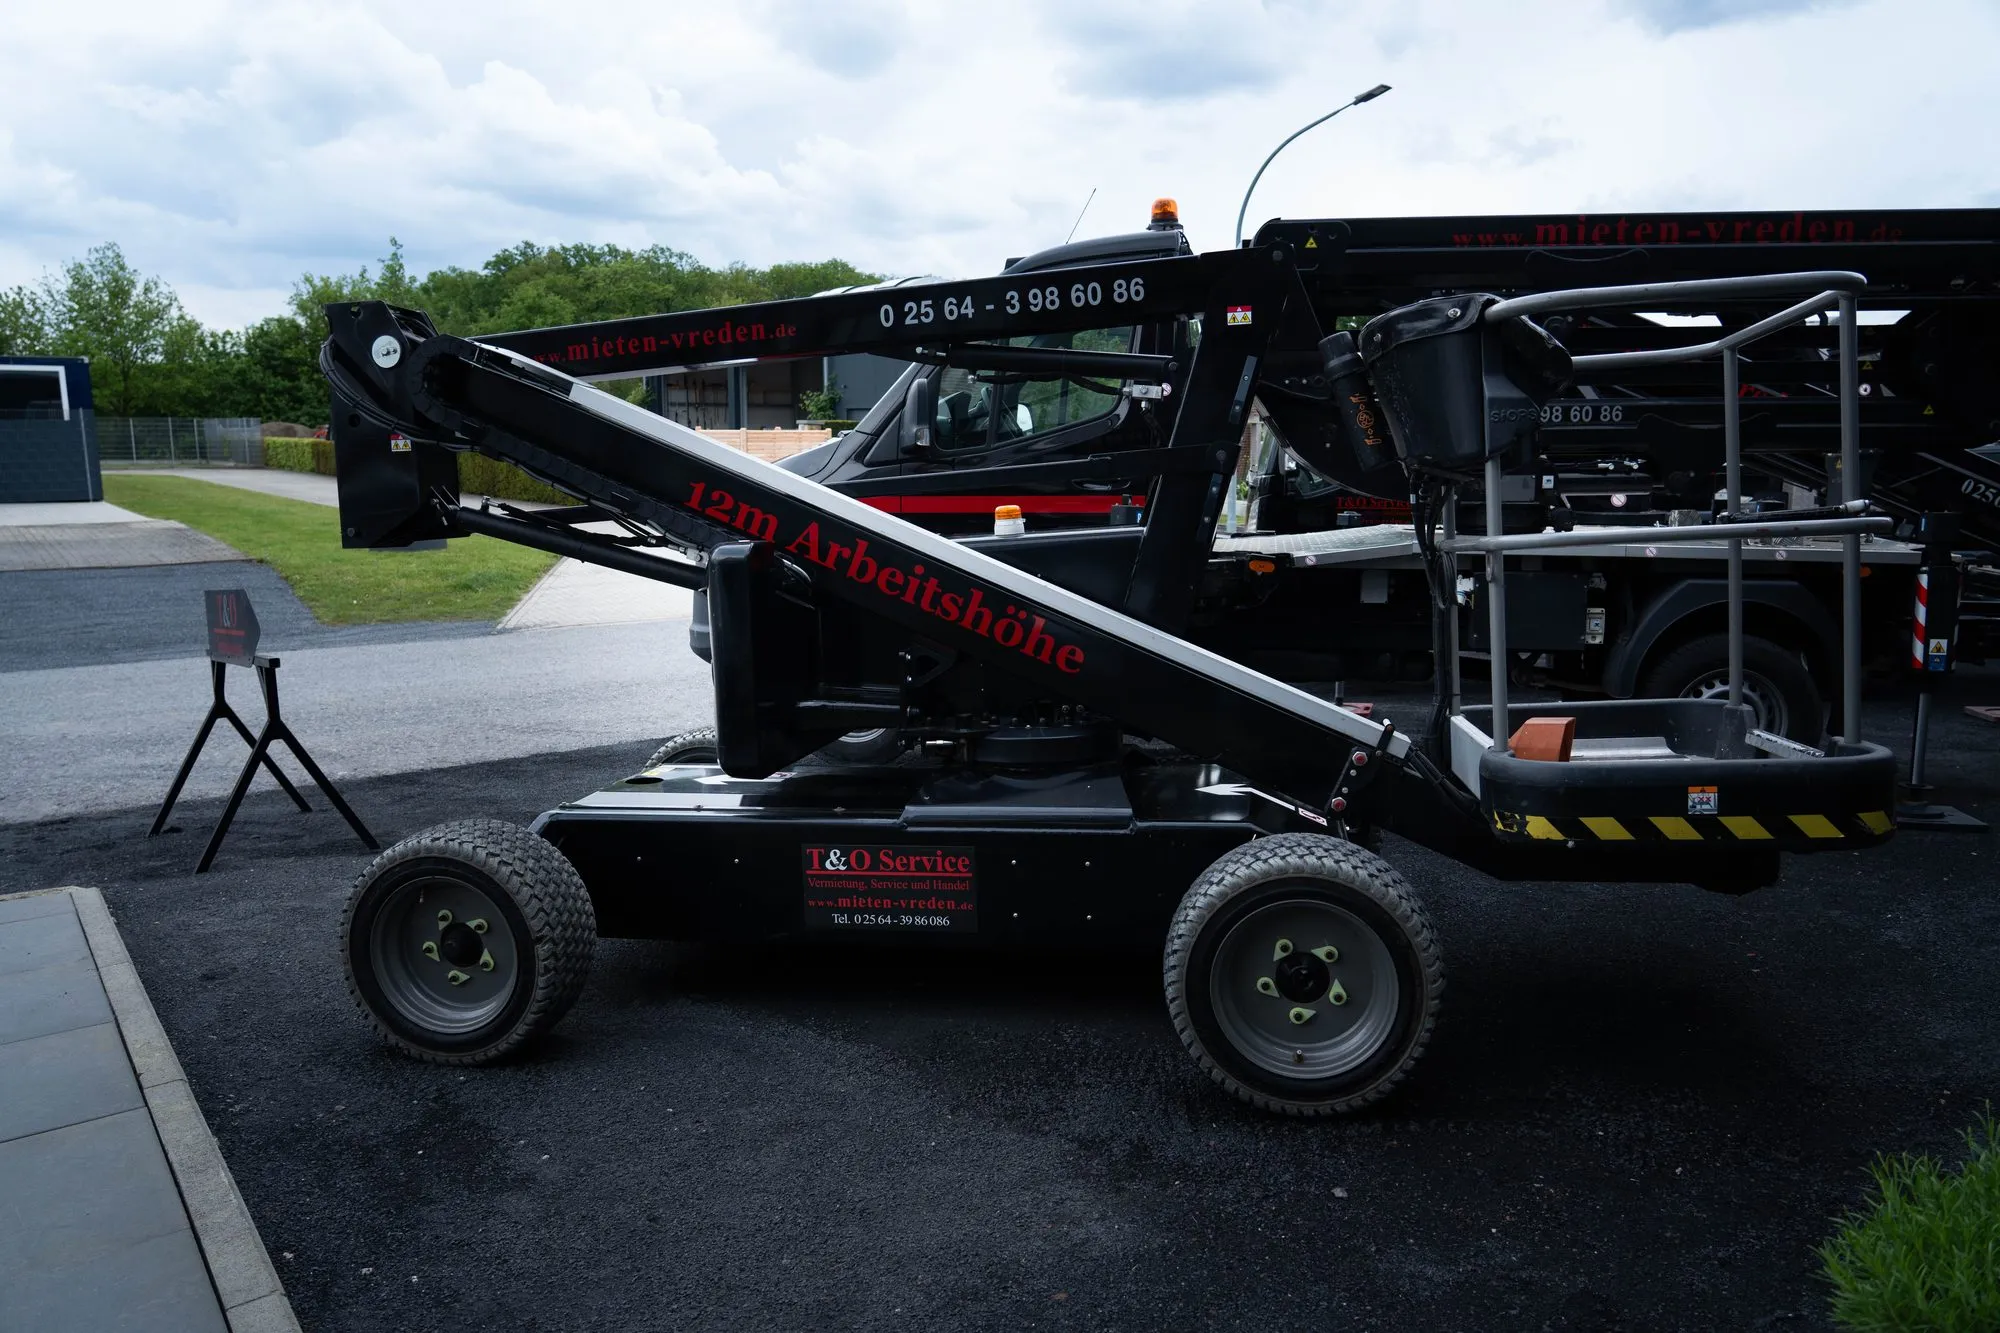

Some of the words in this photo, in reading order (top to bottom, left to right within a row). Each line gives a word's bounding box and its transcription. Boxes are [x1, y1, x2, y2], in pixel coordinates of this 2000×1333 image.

[1452, 212, 1905, 246] www.mieten-vreden.de
[879, 304, 894, 327] 0
[904, 300, 934, 325] 25
[943, 296, 974, 320] 64
[1028, 286, 1060, 312] 98
[1070, 282, 1102, 308] 60
[1112, 277, 1145, 304] 86
[532, 320, 797, 363] ww.mieten-vreden.de
[1570, 405, 1593, 422] 60
[1600, 405, 1623, 422] 86
[682, 481, 779, 543] 12m
[785, 520, 1086, 675] Arbeitshöhe
[806, 848, 871, 871] T&O
[879, 849, 971, 872] Service
[808, 878, 868, 891] Vermietung,
[871, 879, 908, 889] Service
[911, 880, 930, 890] und
[933, 880, 969, 891] Handel
[808, 895, 974, 911] www.mieten-vreden.de
[832, 914, 850, 924] Tel.
